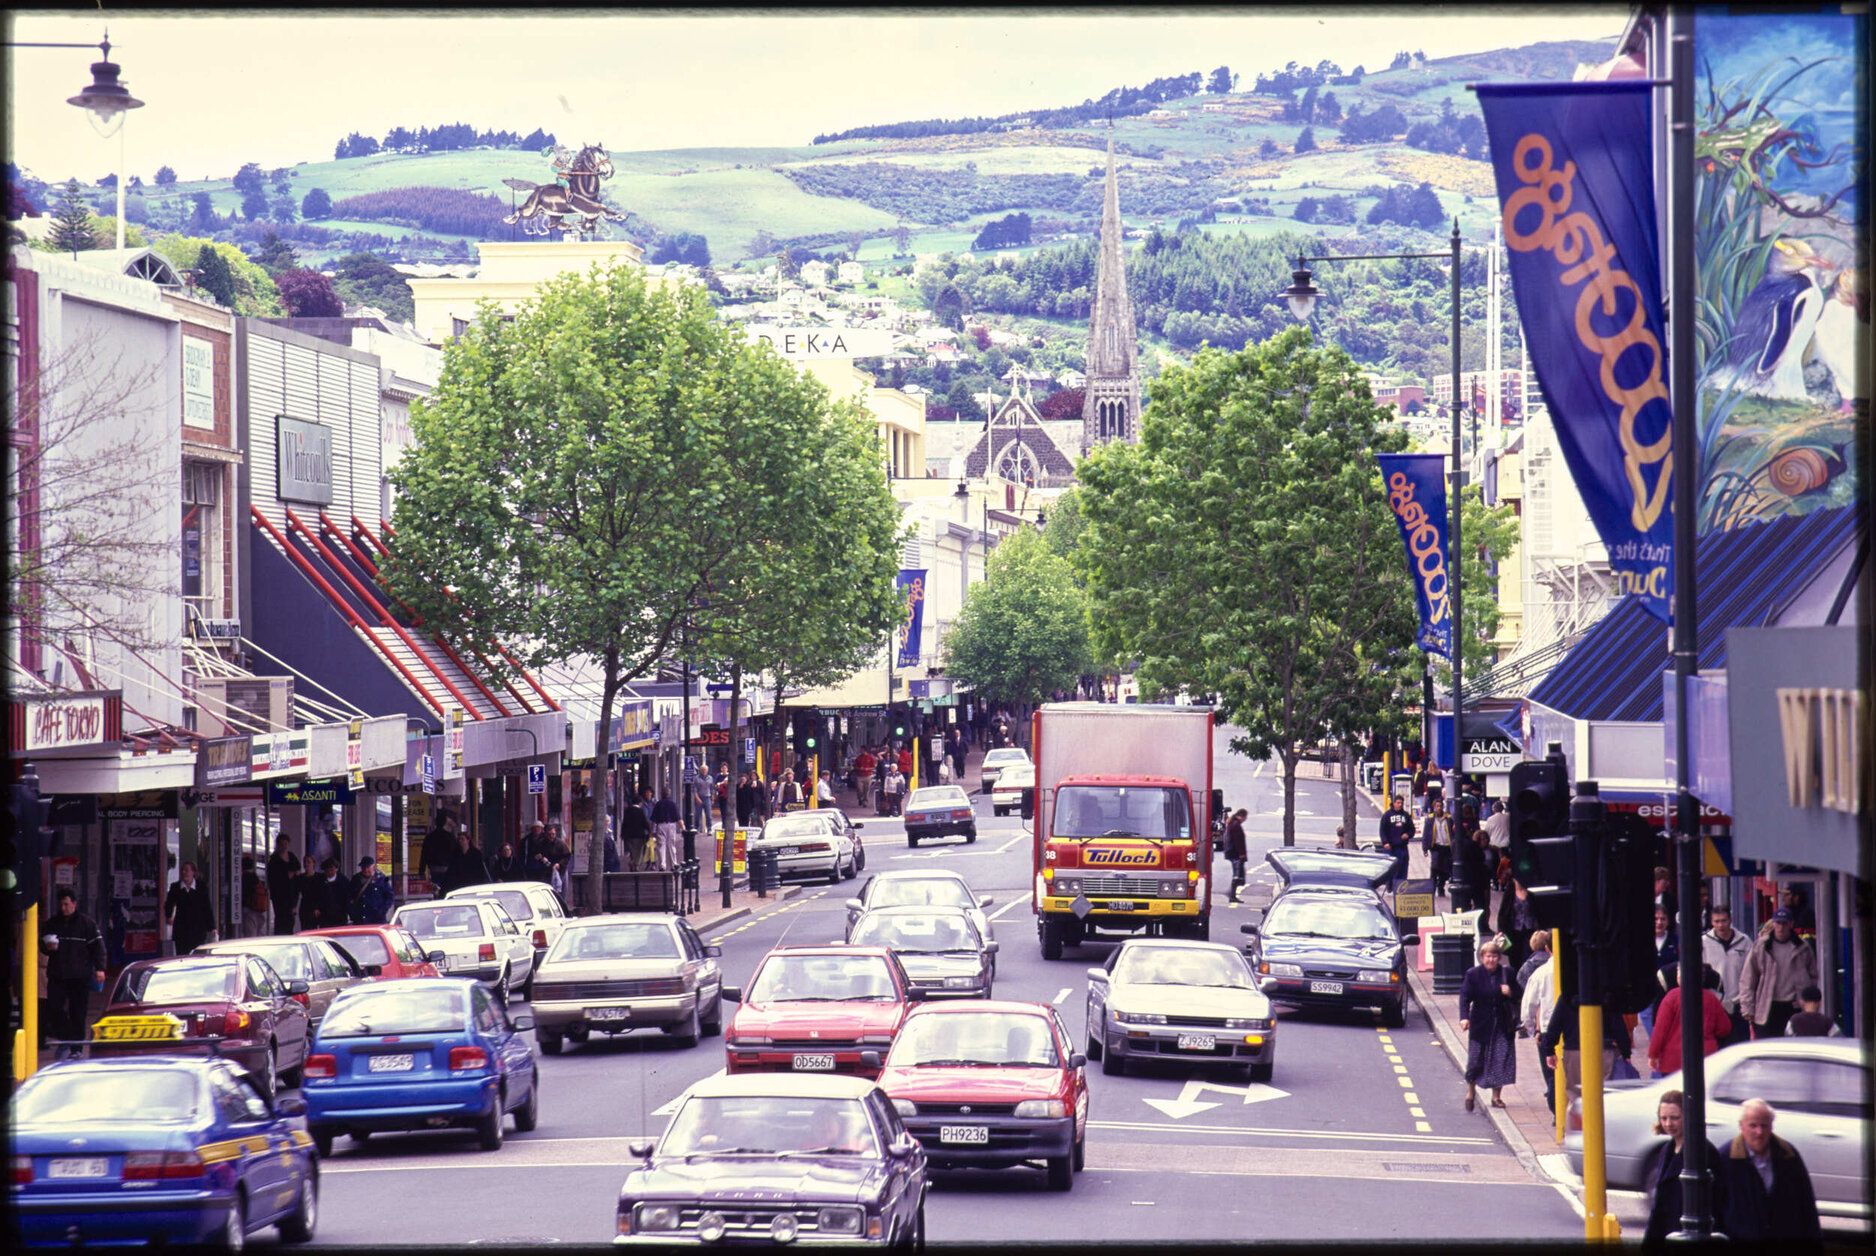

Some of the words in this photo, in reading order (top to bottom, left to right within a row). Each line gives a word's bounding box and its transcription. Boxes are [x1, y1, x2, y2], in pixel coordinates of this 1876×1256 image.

[34, 704, 62, 745] CAFE
[64, 705, 99, 741] TOKYO
[1470, 741, 1511, 753] ALAN
[1472, 756, 1511, 768] DOVE
[533, 766, 540, 775] P
[301, 790, 337, 801] ASANTI
[130, 809, 165, 817] PIERCING
[1390, 814, 1406, 823] USA
[1087, 849, 1157, 864] Tulloch
[1312, 982, 1342, 993] SS9942
[1179, 1035, 1214, 1047] ZJ9265
[795, 1055, 834, 1068] OD5667
[942, 1128, 987, 1141] PH9236
